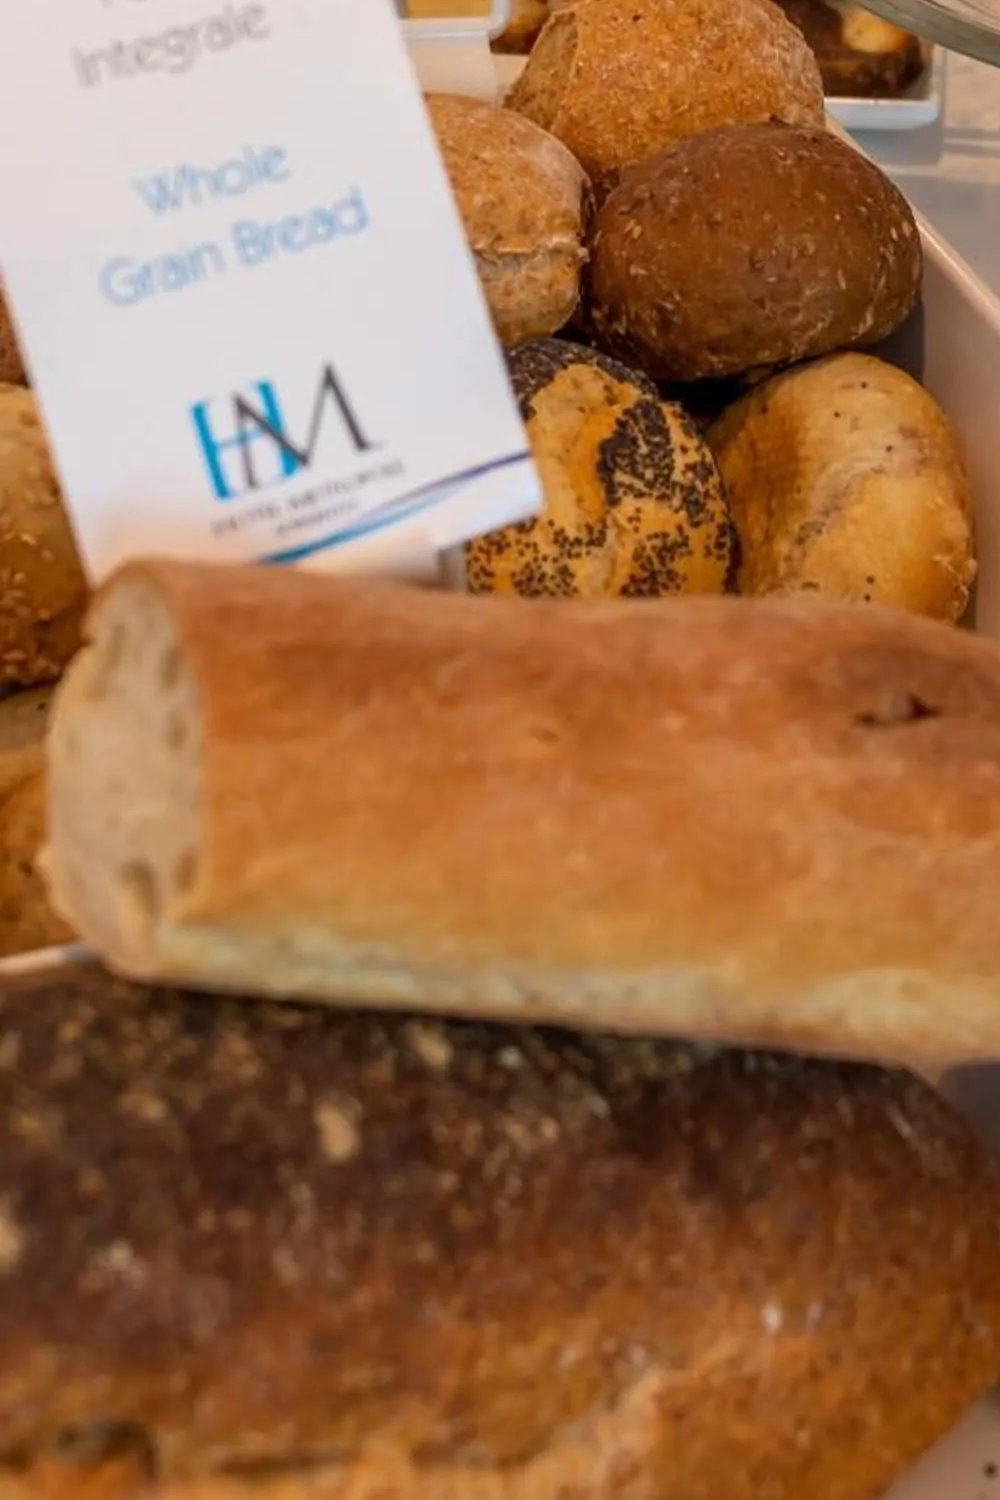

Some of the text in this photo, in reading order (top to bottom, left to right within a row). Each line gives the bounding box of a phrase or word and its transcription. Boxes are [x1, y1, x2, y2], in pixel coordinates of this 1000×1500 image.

[71, 3, 270, 88] Integrale
[132, 145, 291, 216] Whole
[99, 187, 369, 306] Grain Bread
